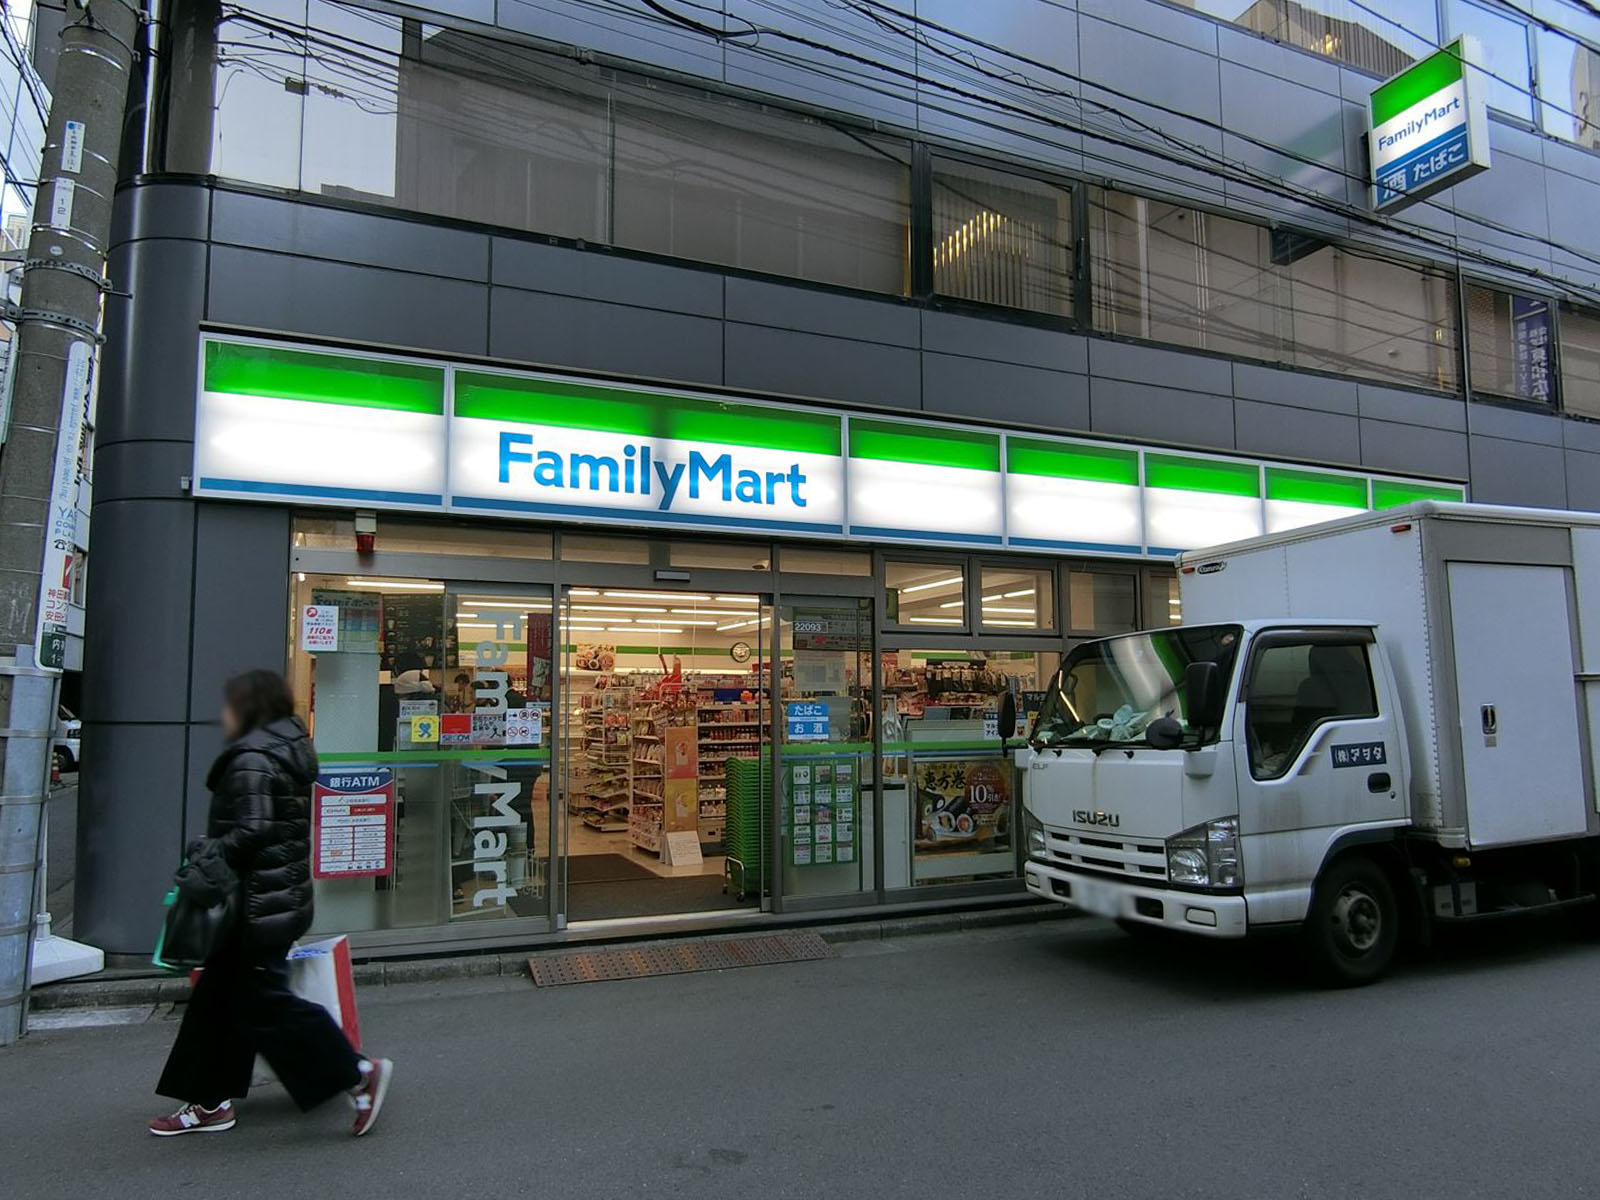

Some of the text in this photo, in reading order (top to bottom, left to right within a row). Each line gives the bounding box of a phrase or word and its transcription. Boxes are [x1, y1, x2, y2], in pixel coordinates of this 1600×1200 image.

[1377, 97, 1460, 151] FamilyMart
[1382, 142, 1464, 199] 酒 たばこ
[498, 431, 807, 511] FamilyMart
[794, 622, 822, 631] 22093
[794, 704, 823, 716] たばこ
[329, 776, 380, 788] 銀行ATM
[923, 769, 967, 791] 恵方巻
[1072, 809, 1120, 827] ISUZU
